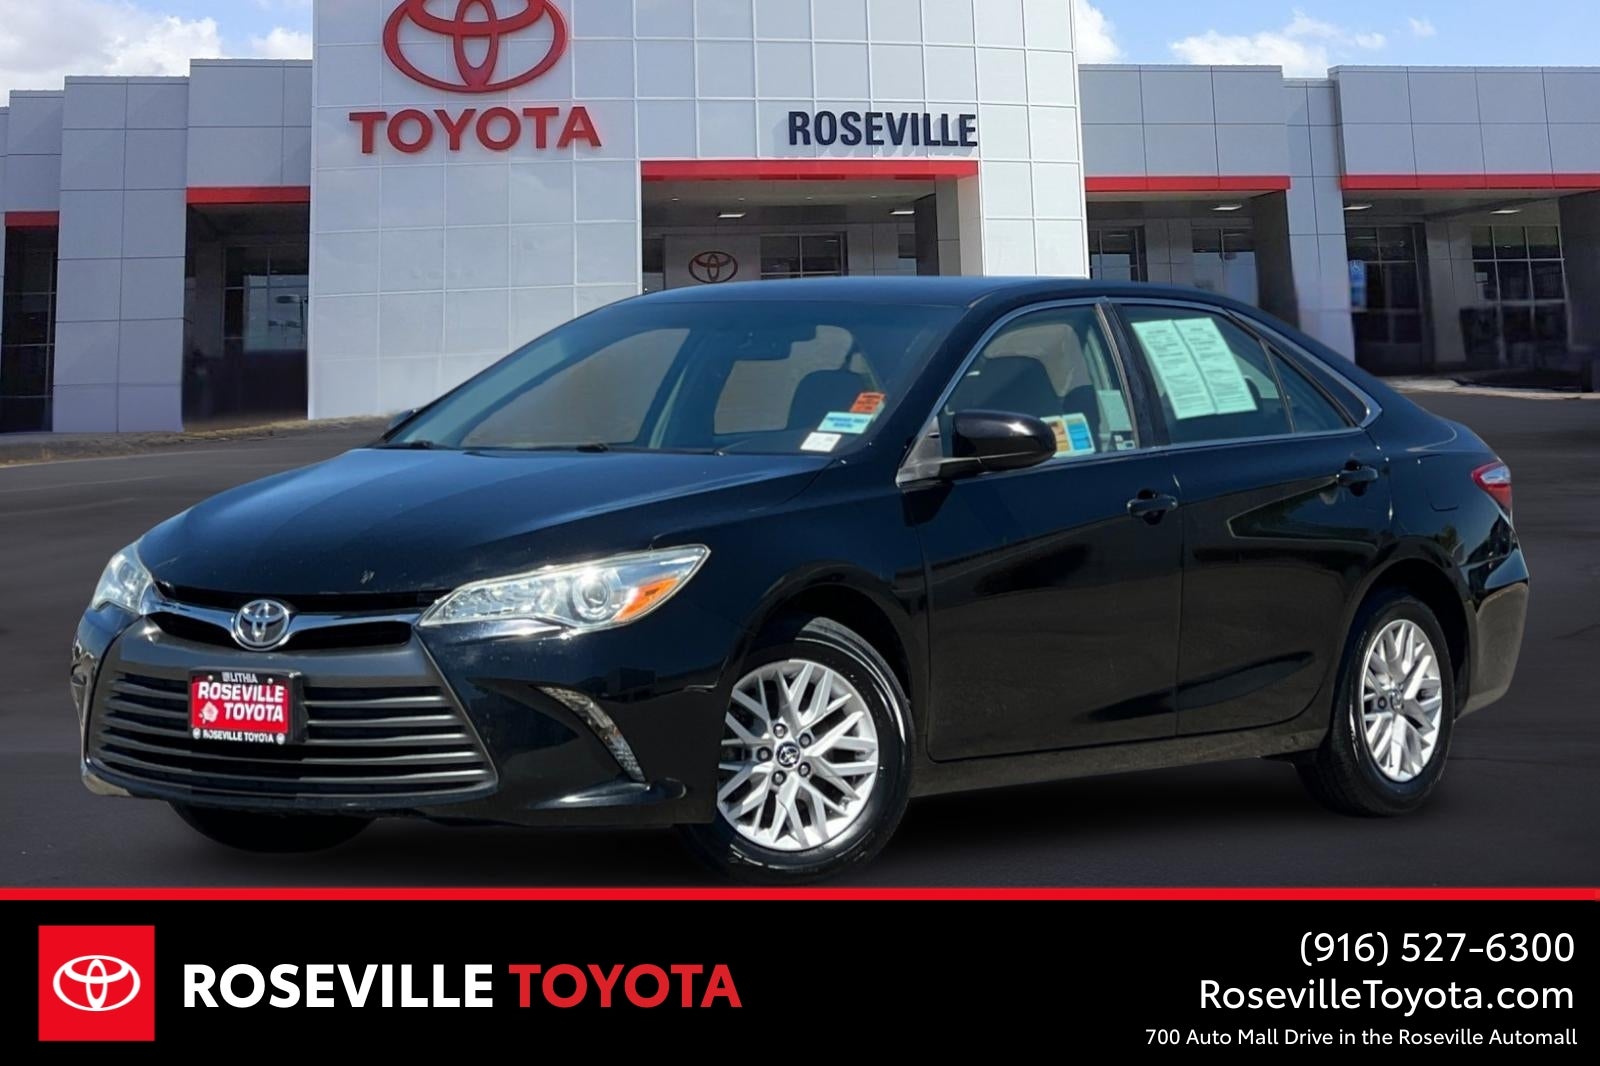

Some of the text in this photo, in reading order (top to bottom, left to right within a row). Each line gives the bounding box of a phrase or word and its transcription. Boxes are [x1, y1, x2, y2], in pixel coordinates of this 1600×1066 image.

[349, 106, 602, 154] TOYOTA
[788, 110, 978, 147] ROSEVILLE
[230, 672, 258, 684] LITHIA
[198, 681, 284, 703] ROSEVILLE
[224, 701, 284, 722] TOYOTA
[202, 729, 274, 743] ROSEVILLE TOYOTA
